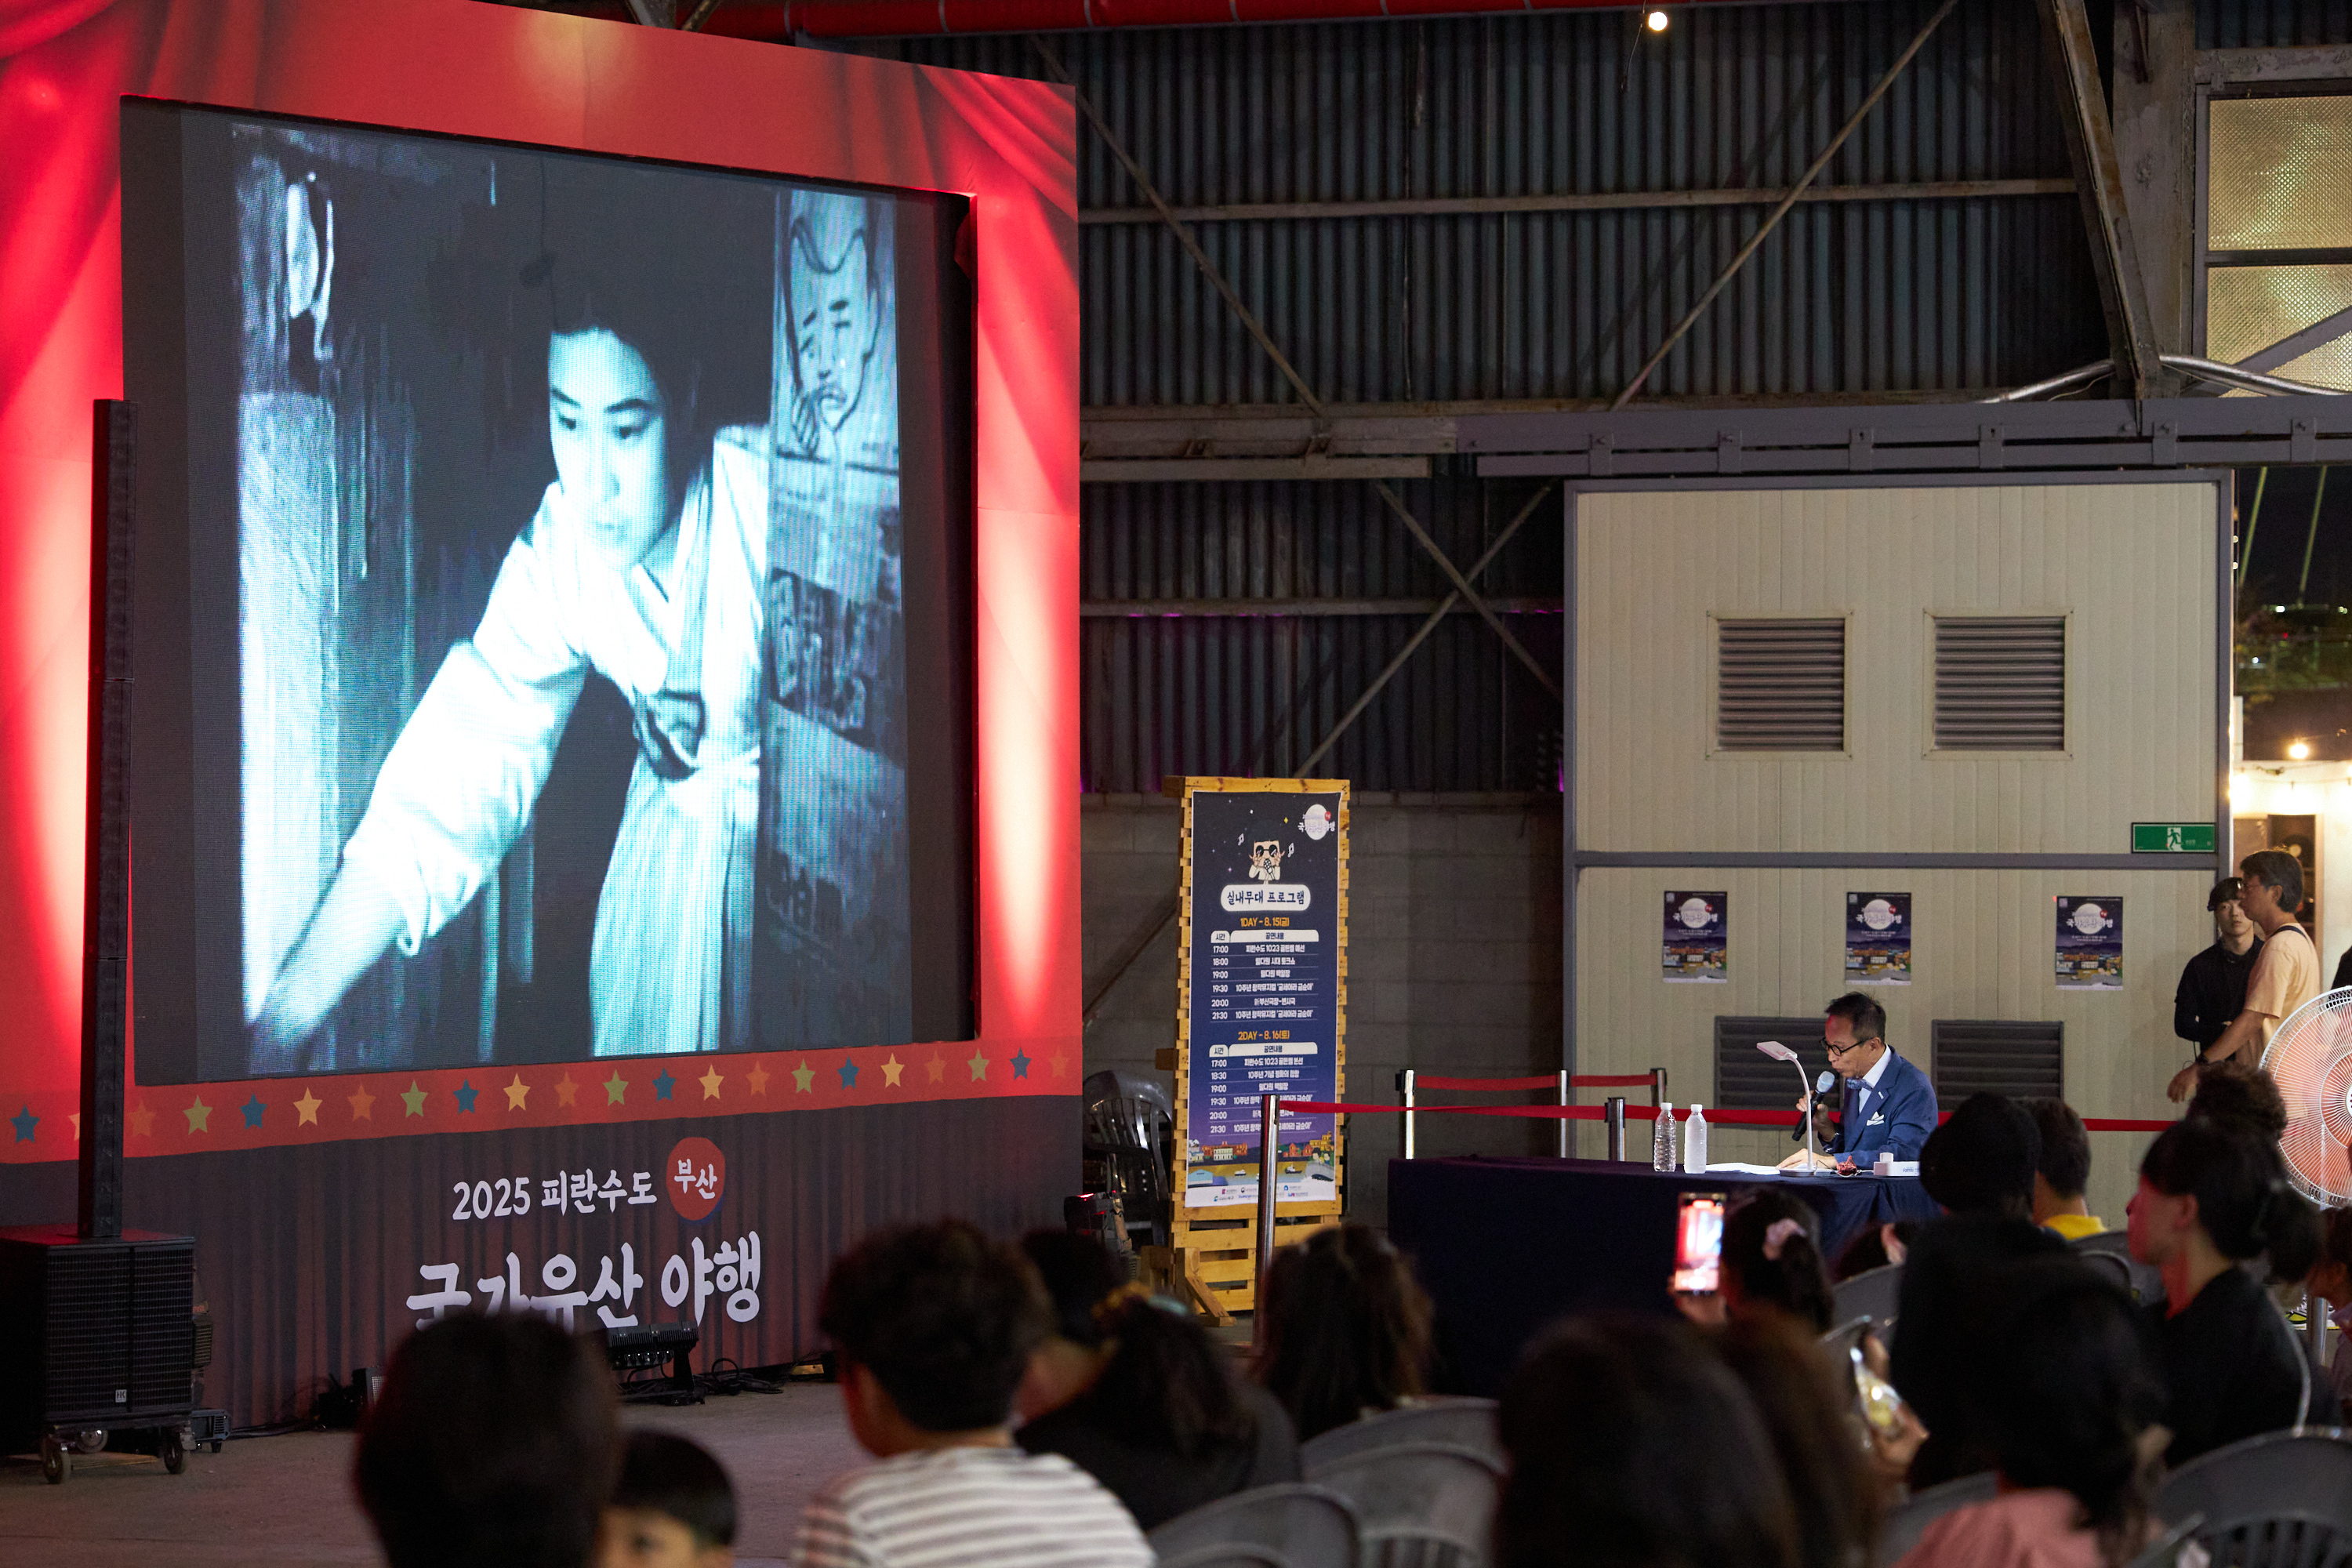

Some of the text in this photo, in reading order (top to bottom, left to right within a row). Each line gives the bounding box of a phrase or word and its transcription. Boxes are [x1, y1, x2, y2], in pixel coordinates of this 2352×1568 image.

[1227, 890, 1305, 906] 실내무대 프로그램
[1240, 917, 1258, 927] 1DAY
[1215, 932, 1225, 941] 시간
[1213, 957, 1229, 966] 18:00
[1212, 984, 1228, 993] 19:30
[1236, 984, 1251, 993] 10주년
[1211, 999, 1229, 1007] 20:00
[1236, 1011, 1251, 1019] 10주년
[1238, 1031, 1258, 1040] 2DAY
[1265, 1057, 1278, 1065] 1023
[1248, 1070, 1263, 1079] 10주년
[1210, 1084, 1226, 1093] 19:00
[1210, 1097, 1226, 1105] 19:30
[1233, 1096, 1249, 1105] 10주년
[1209, 1111, 1227, 1120] 20:00
[1234, 1123, 1250, 1132] 10주년
[452, 1159, 717, 1220] 2025 피란수도 부산
[406, 1231, 760, 1332] 국가유산 야행
